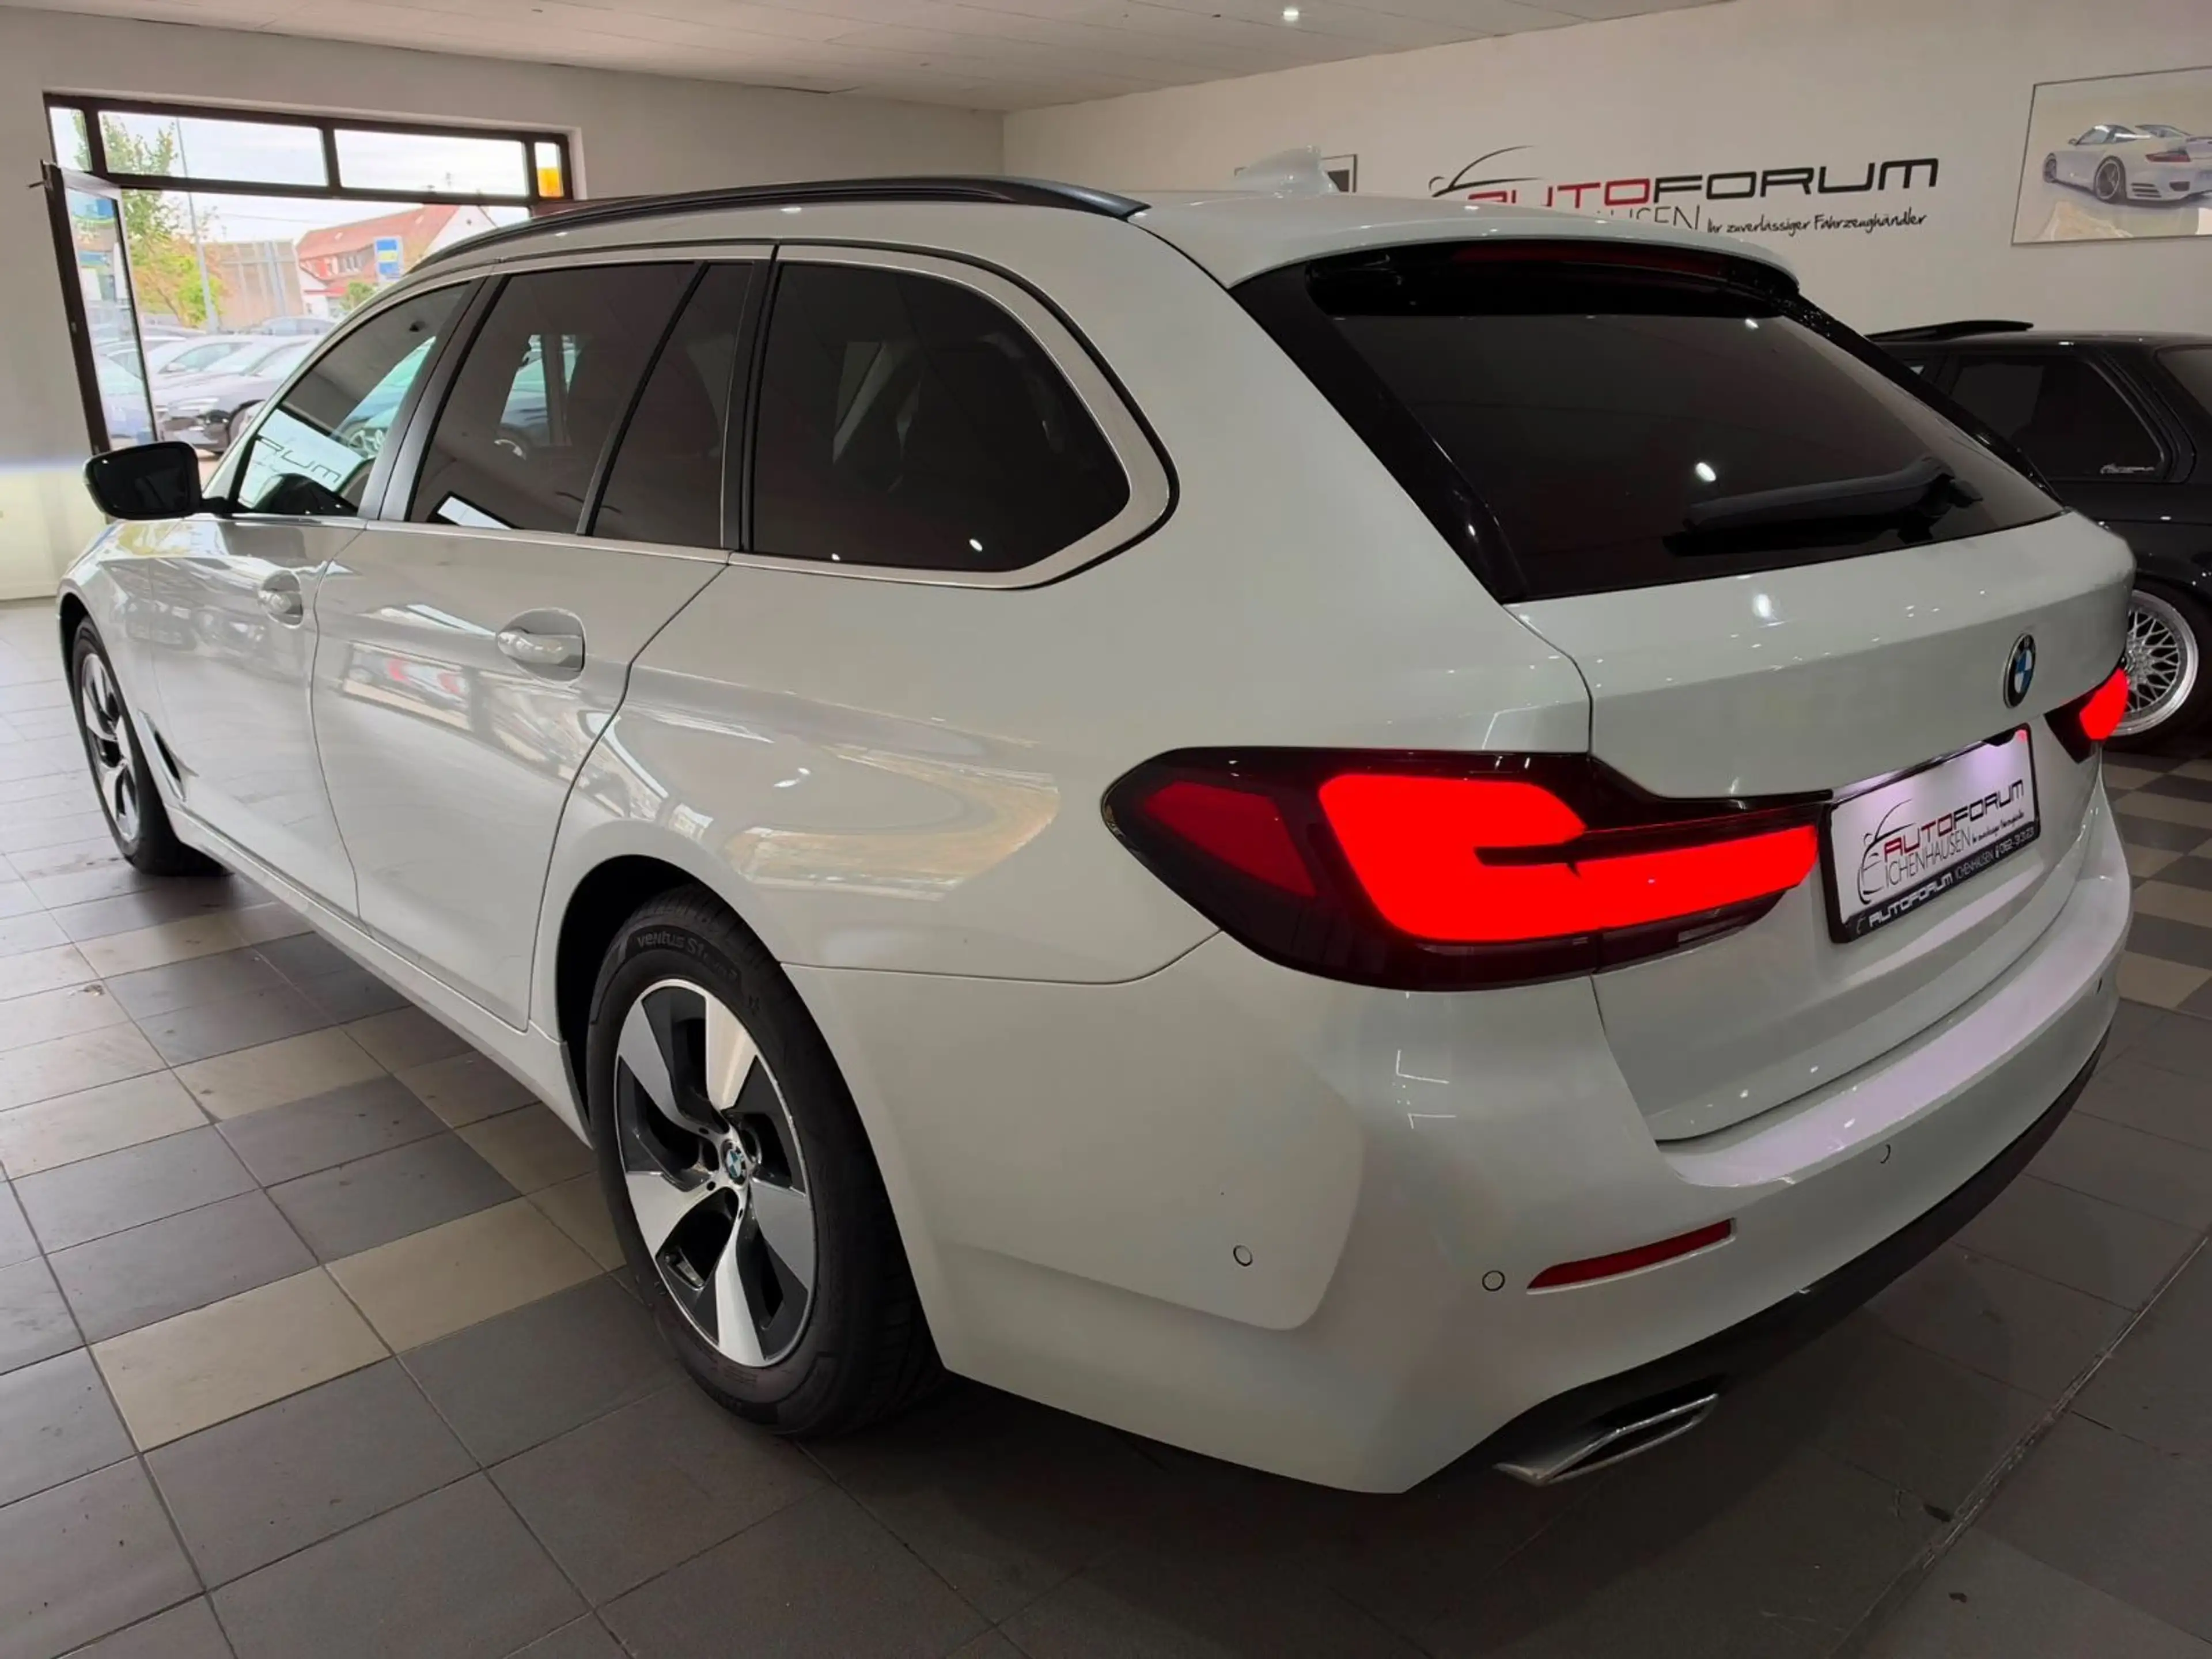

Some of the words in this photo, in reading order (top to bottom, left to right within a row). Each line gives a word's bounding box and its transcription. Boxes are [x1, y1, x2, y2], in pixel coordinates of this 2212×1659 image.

[1707, 217, 1722, 233] Ihr
[1884, 779, 2024, 863] AUTOFORUM
[1868, 873, 1954, 928] AUTOFORUM
